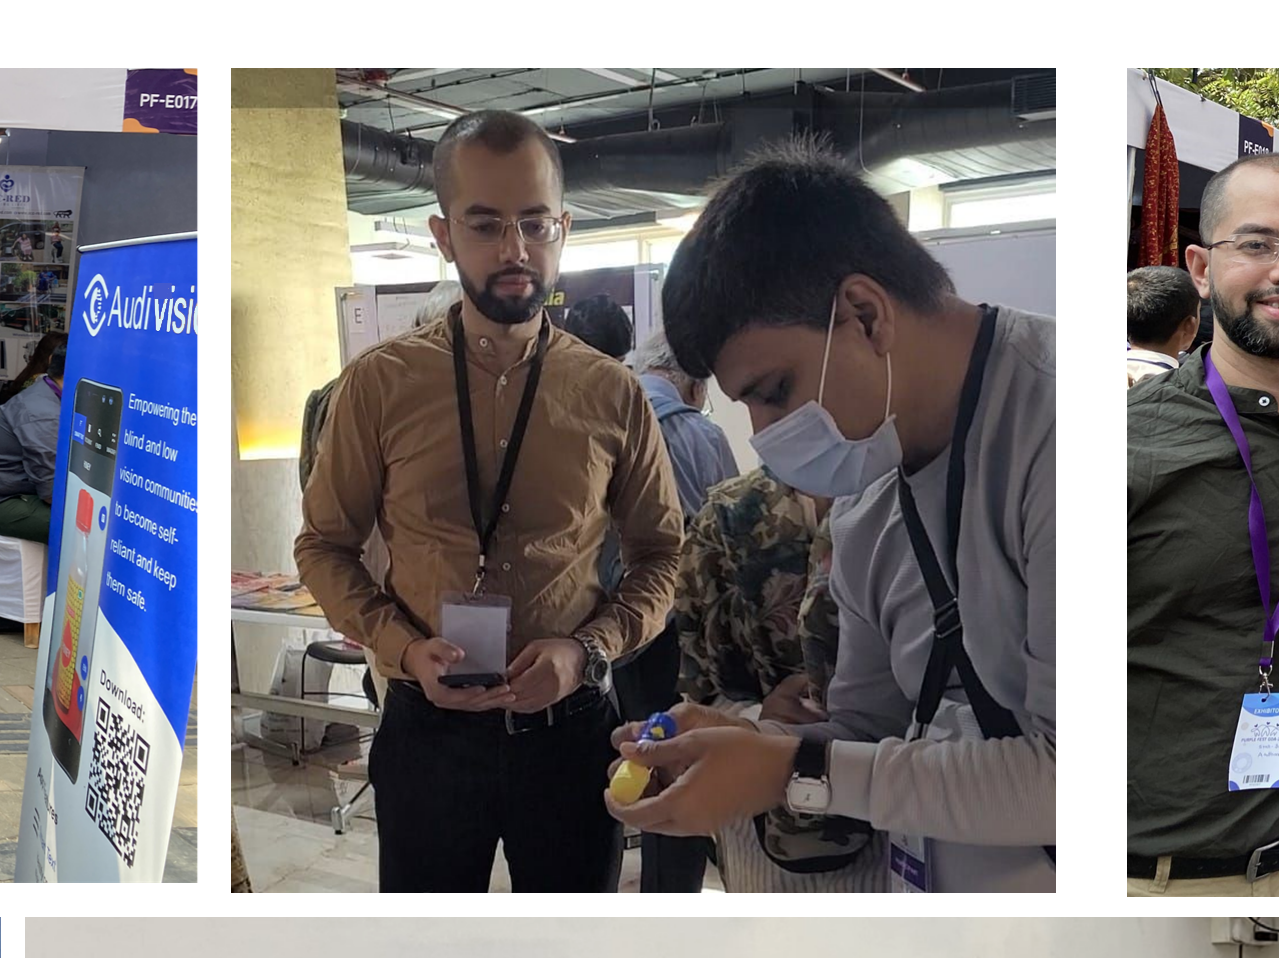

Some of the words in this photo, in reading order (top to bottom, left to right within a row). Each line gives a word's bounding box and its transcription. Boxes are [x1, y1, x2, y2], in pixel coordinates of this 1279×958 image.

[139, 93, 198, 110] PF-E017
[354, 307, 363, 324] E
[128, 393, 181, 426] Empowering
[180, 406, 197, 427] the
[123, 428, 145, 450] blind
[145, 439, 162, 457] and
[162, 442, 179, 462] low
[120, 465, 143, 489] vision
[114, 501, 123, 518] to
[123, 504, 158, 536] become
[158, 525, 179, 545] self-
[109, 538, 136, 564] reliant
[135, 553, 153, 574] and
[153, 560, 177, 591] keep
[106, 571, 126, 597] them
[126, 588, 147, 612] safe.
[99, 669, 146, 724] Download:
